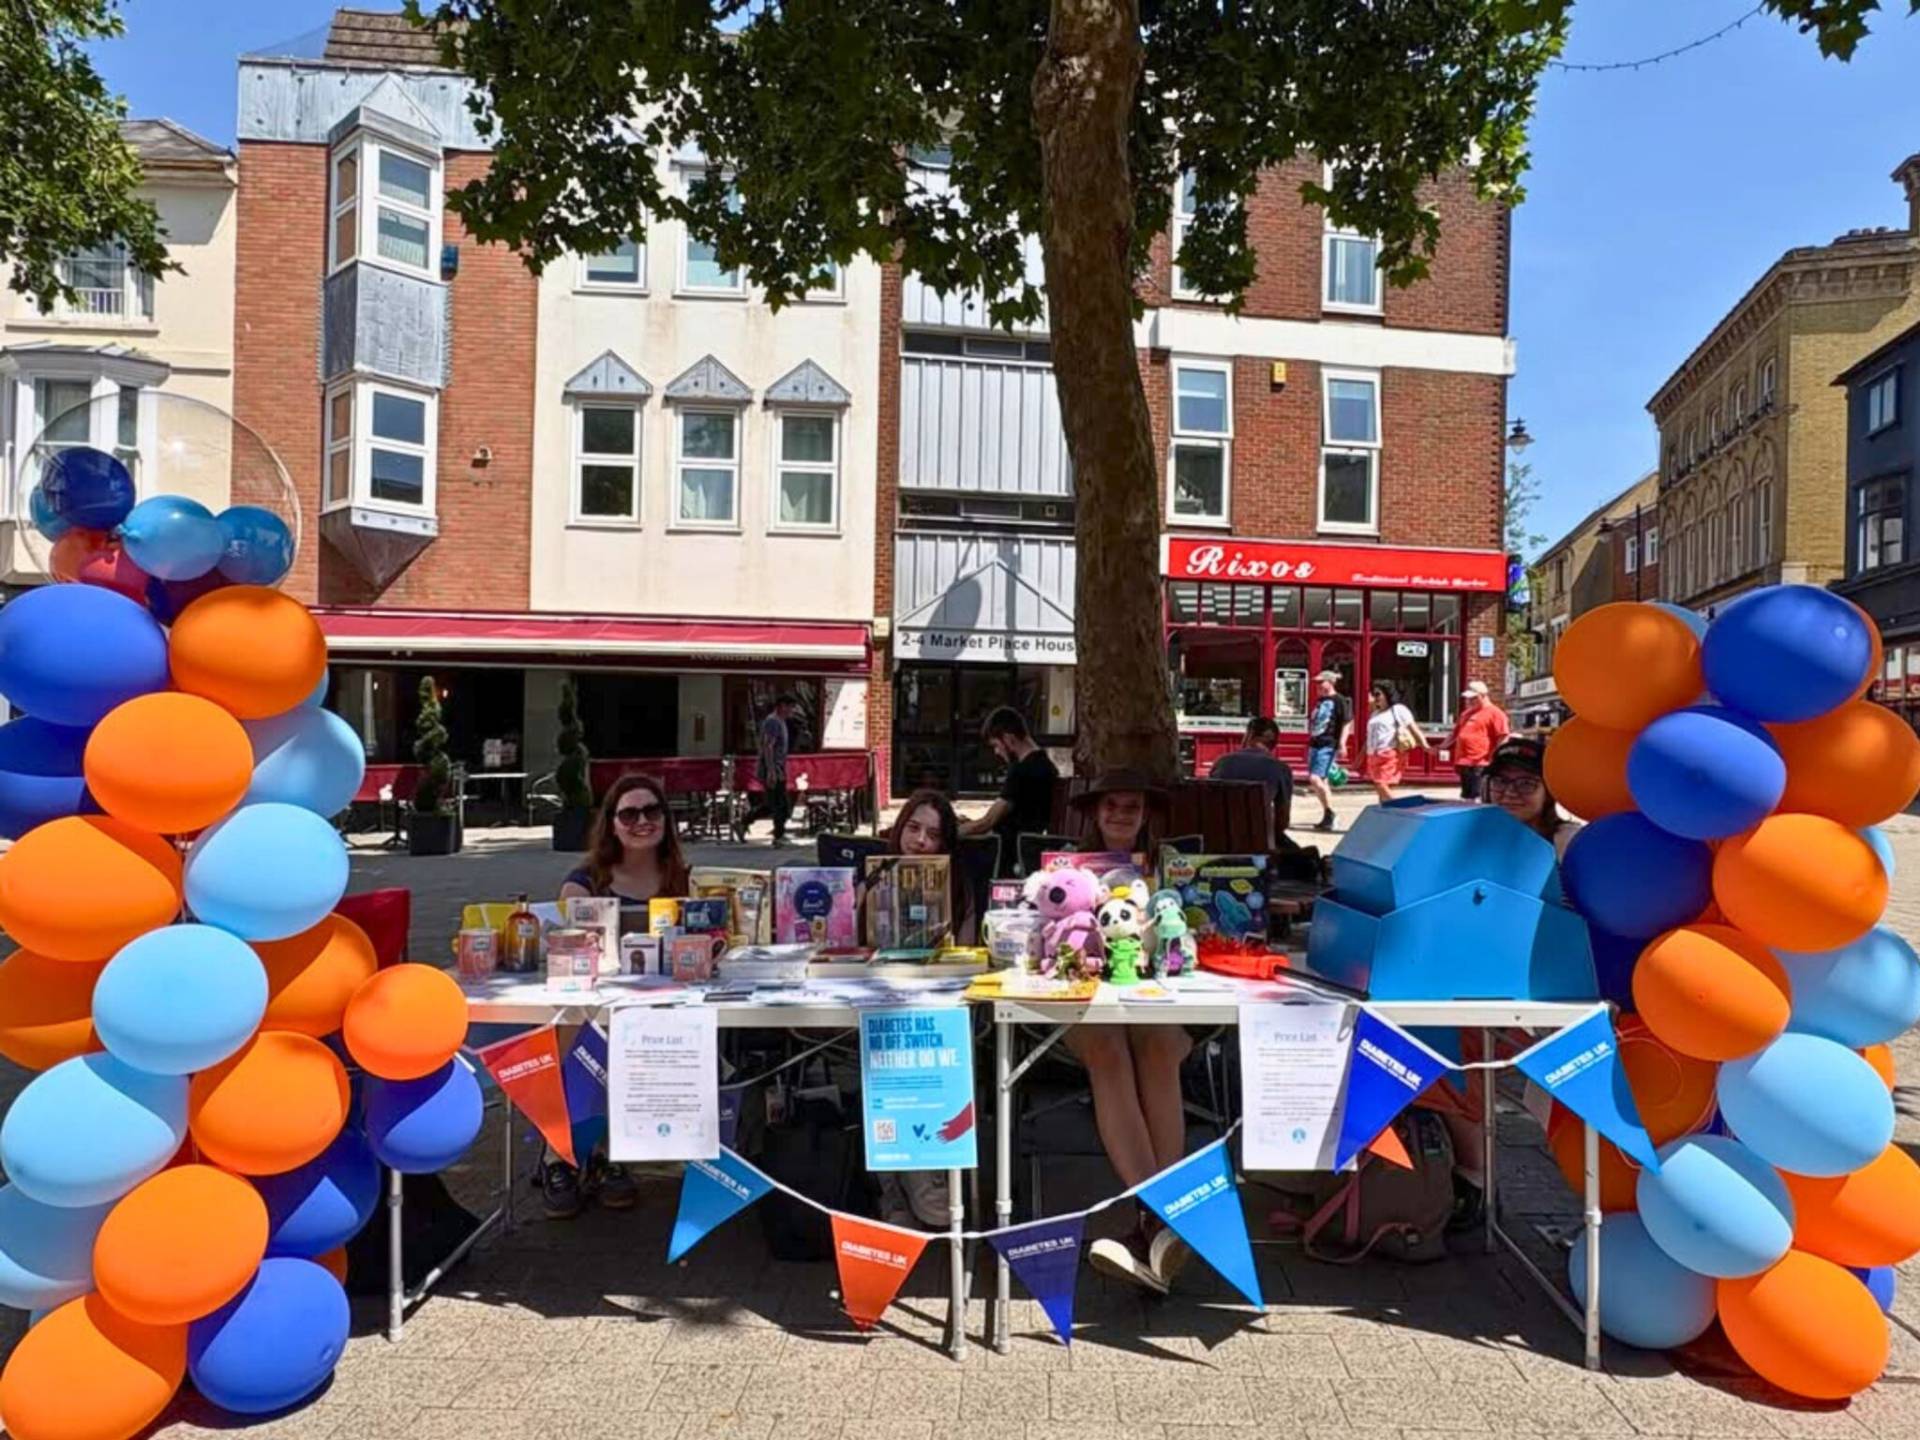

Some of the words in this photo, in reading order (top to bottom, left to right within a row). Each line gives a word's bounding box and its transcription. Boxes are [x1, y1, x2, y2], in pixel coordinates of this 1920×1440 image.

[1186, 545, 1316, 579] Rixos
[901, 633, 925, 647] 2-4
[930, 634, 983, 650] Market
[988, 636, 1030, 651] Place
[1035, 638, 1075, 652] Hous
[868, 1017, 913, 1034] DIABETES
[915, 1016, 935, 1032] HAS
[641, 1035, 664, 1045] Price
[666, 1035, 683, 1045] List
[868, 1035, 882, 1051] NO
[885, 1034, 902, 1050] OFF
[904, 1033, 944, 1049] SWITCH
[1274, 1032, 1298, 1042] Price
[1300, 1032, 1318, 1042] List
[497, 1058, 540, 1079] DIABETES
[540, 1053, 555, 1064] UK
[869, 1050, 915, 1069] NEITHER
[918, 1049, 936, 1068] DO
[1359, 1038, 1408, 1078] DIABETES
[1406, 1069, 1423, 1087] UK
[1544, 1050, 1594, 1084] DIABETES
[1593, 1041, 1611, 1056] UK
[699, 1159, 738, 1189] IABETES
[736, 1184, 751, 1198] UK
[1163, 1183, 1212, 1216] DIABETES
[1211, 1173, 1228, 1189] UK
[841, 1240, 892, 1262] DIABETES
[892, 1252, 907, 1265] UK
[1006, 1239, 1058, 1257] DIABETES
[1059, 1235, 1075, 1247] UK
